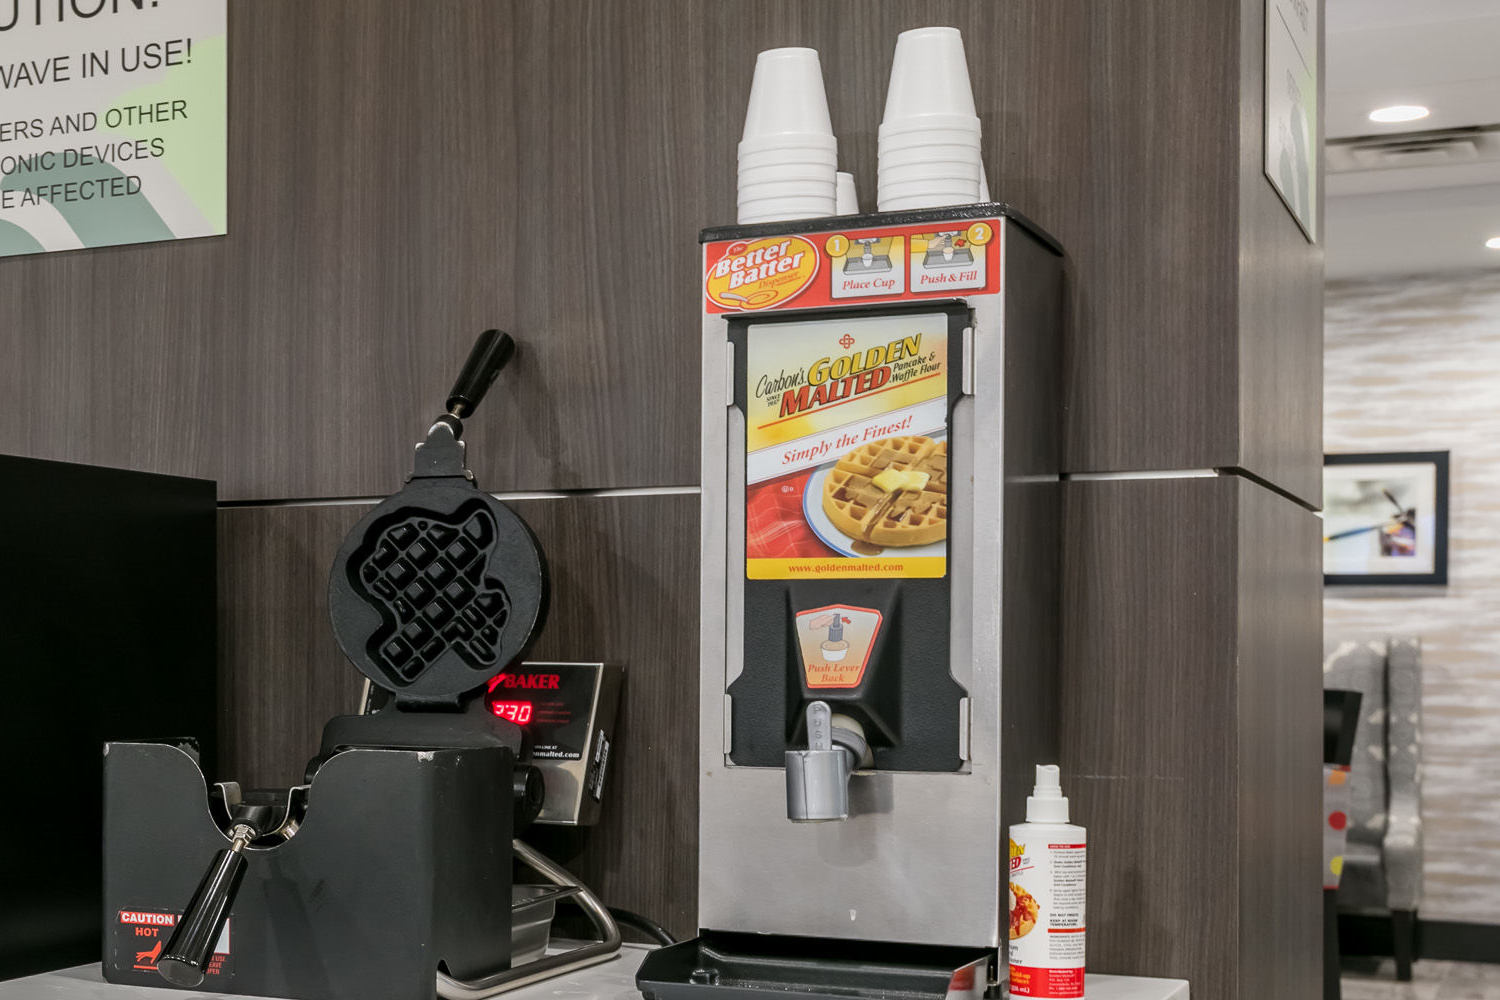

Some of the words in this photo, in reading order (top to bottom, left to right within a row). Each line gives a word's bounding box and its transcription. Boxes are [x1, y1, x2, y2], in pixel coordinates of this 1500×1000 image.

[81, 50, 109, 78] IN
[121, 38, 192, 72] USE!
[50, 112, 97, 136] AND
[104, 100, 188, 128] OTHER
[63, 138, 165, 168] DEVICES
[21, 175, 141, 207] AFFECTED
[975, 227, 984, 240] 2
[834, 240, 840, 251] 1
[715, 240, 791, 278] Better
[729, 252, 804, 290] Batter
[920, 273, 946, 284] Push
[948, 274, 956, 282] &
[959, 271, 977, 281] Fill
[842, 280, 870, 290] Place
[873, 278, 895, 289] Cup
[808, 333, 922, 387] GOLDEN
[893, 357, 927, 372] Pancake
[892, 369, 918, 384] Waffle
[920, 362, 941, 376] Flour
[779, 366, 892, 418] MALTED
[782, 442, 832, 465] Simply
[836, 432, 859, 449] the
[863, 415, 913, 445] Finest!
[789, 562, 903, 573] www.goldenmalted.com
[808, 664, 831, 672] Push
[505, 674, 559, 688] BAKER
[122, 913, 173, 924] CAUTION
[135, 928, 159, 937] HOT
